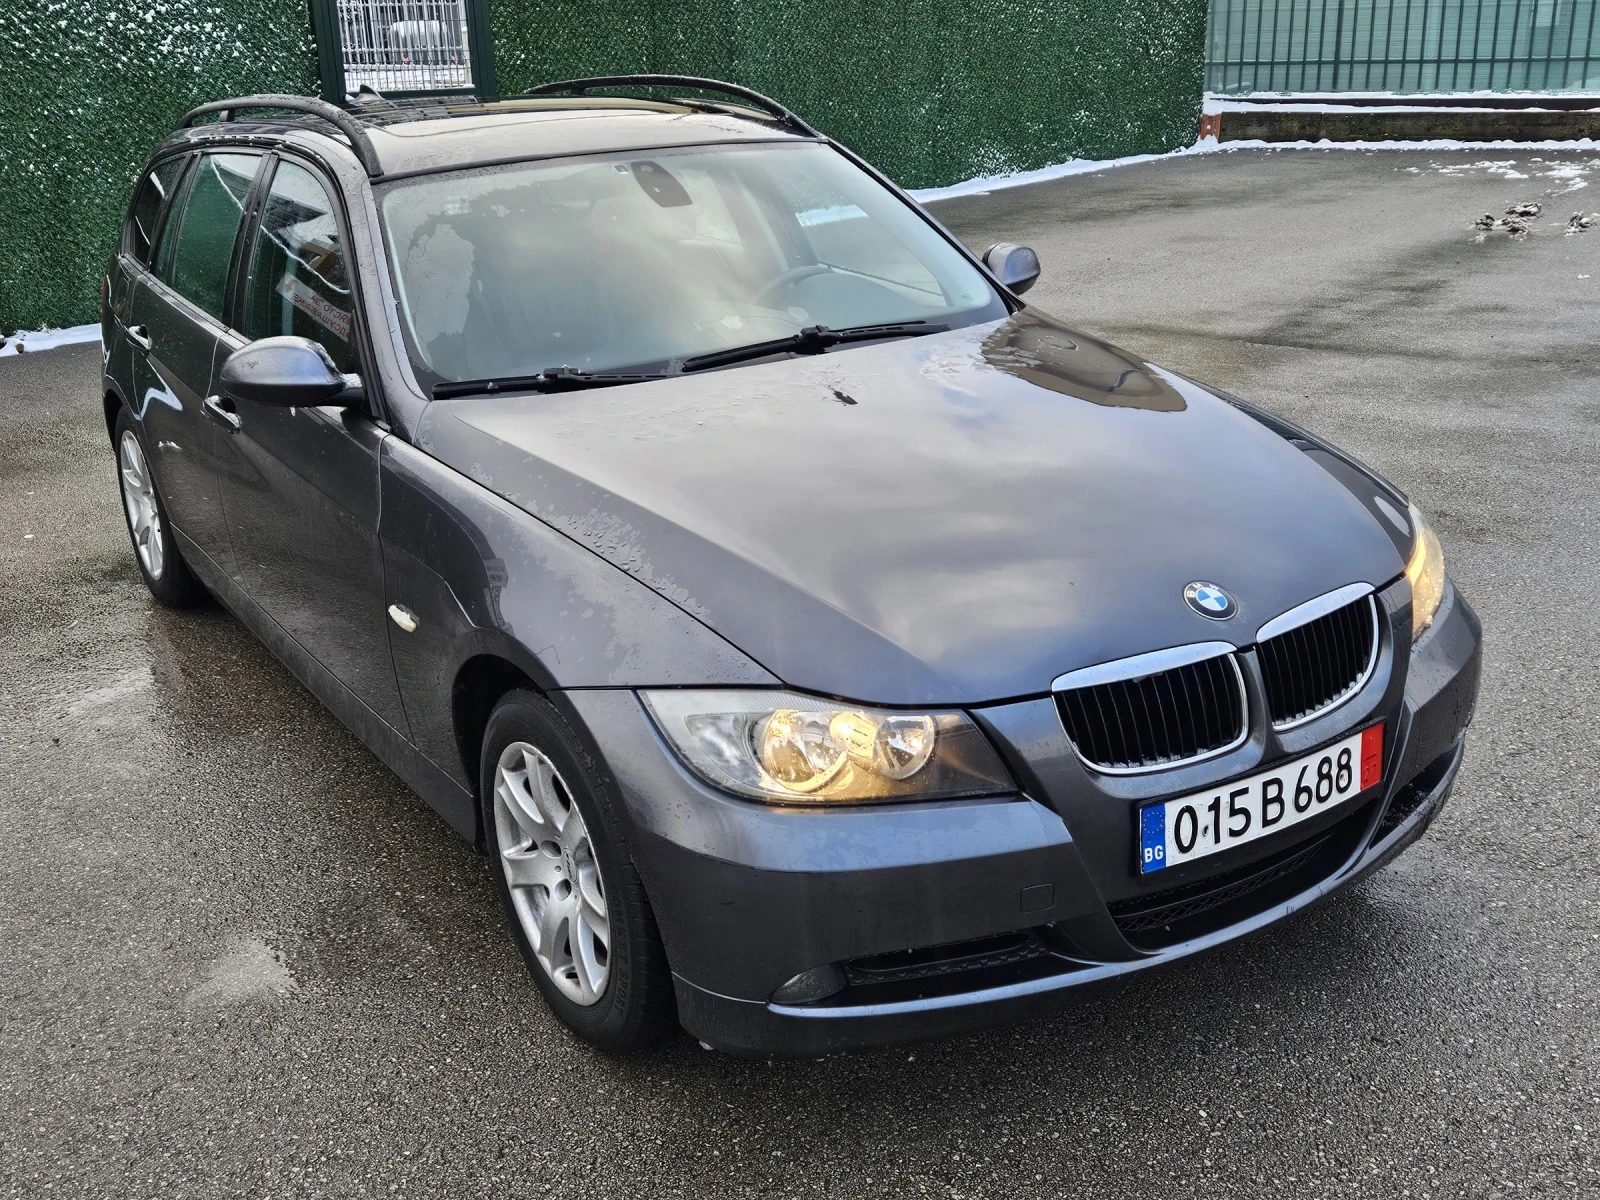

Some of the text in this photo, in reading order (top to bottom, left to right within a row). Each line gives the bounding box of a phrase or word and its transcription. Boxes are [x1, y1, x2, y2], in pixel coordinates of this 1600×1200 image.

[1186, 582, 1220, 598] BMW
[1363, 763, 1377, 783] 27
[1144, 845, 1164, 863] BG
[614, 967, 629, 1016] SPORT
